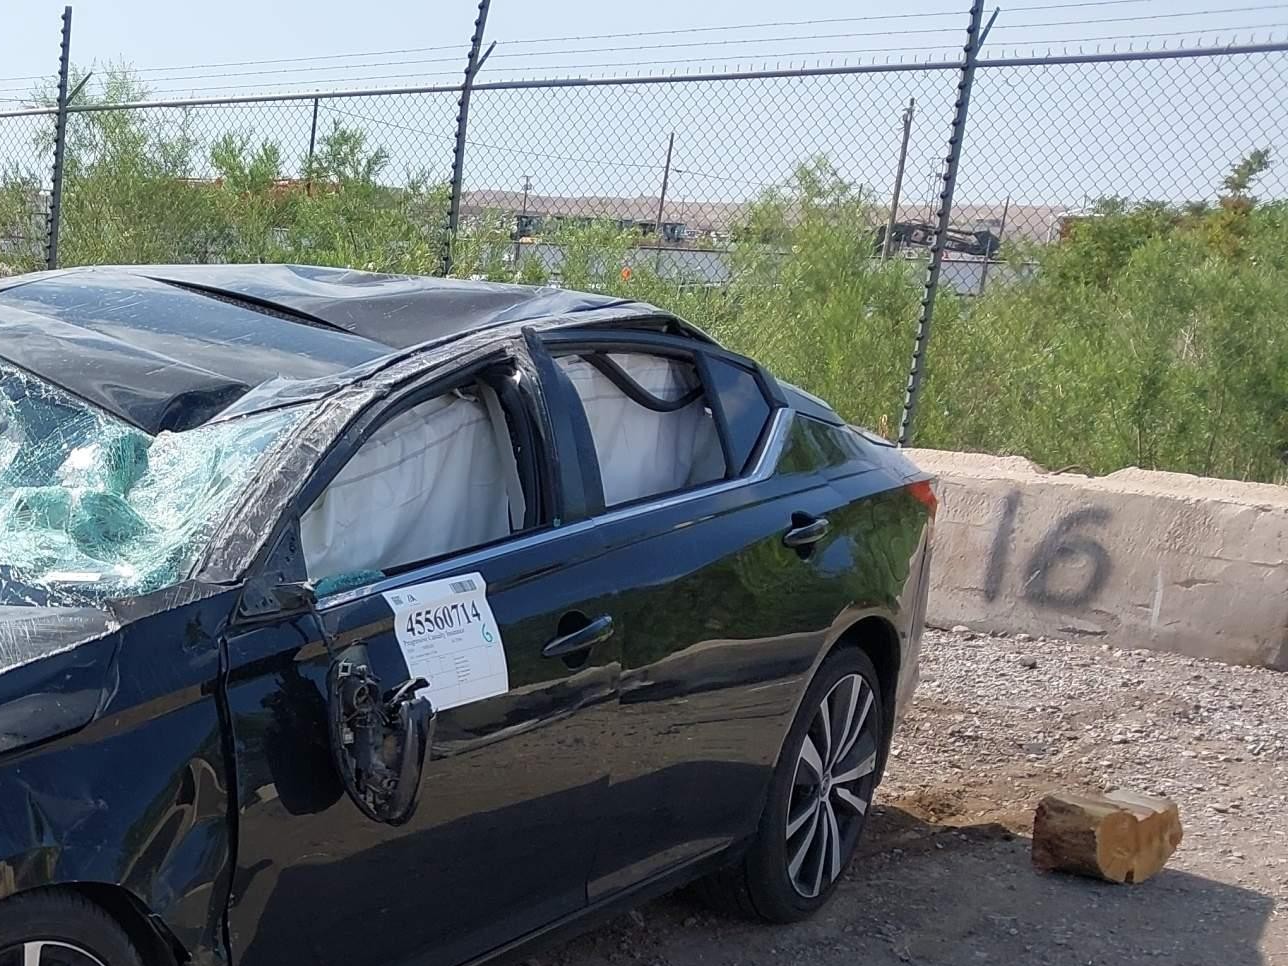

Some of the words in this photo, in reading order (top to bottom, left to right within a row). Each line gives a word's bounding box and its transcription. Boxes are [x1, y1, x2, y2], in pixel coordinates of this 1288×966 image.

[984, 489, 1112, 607] 16
[406, 600, 481, 637] 45560714
[481, 623, 494, 643] 6
